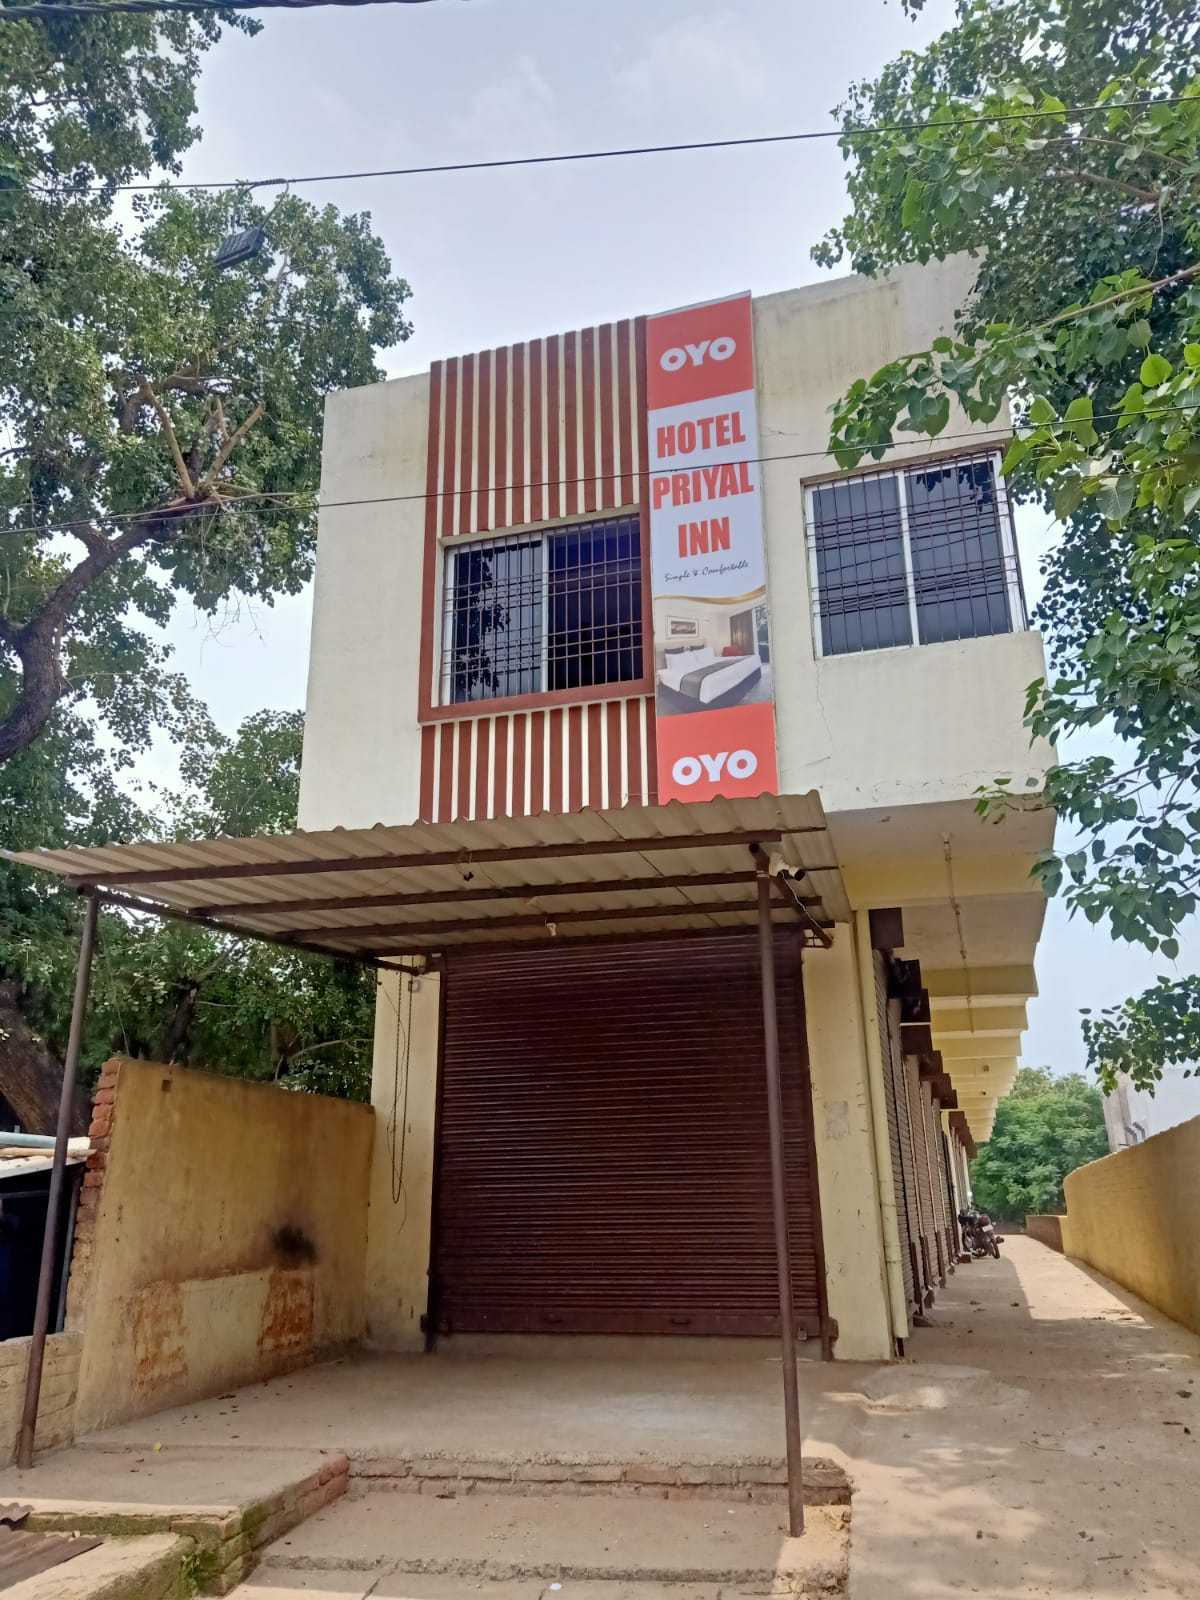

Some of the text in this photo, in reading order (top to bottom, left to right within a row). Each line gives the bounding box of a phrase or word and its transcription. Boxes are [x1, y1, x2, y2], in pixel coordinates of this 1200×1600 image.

[660, 336, 736, 372] OYO
[656, 411, 746, 458] HOTEL
[653, 462, 754, 509] PRIYAL
[677, 516, 731, 558] INN
[672, 749, 758, 786] OYO
